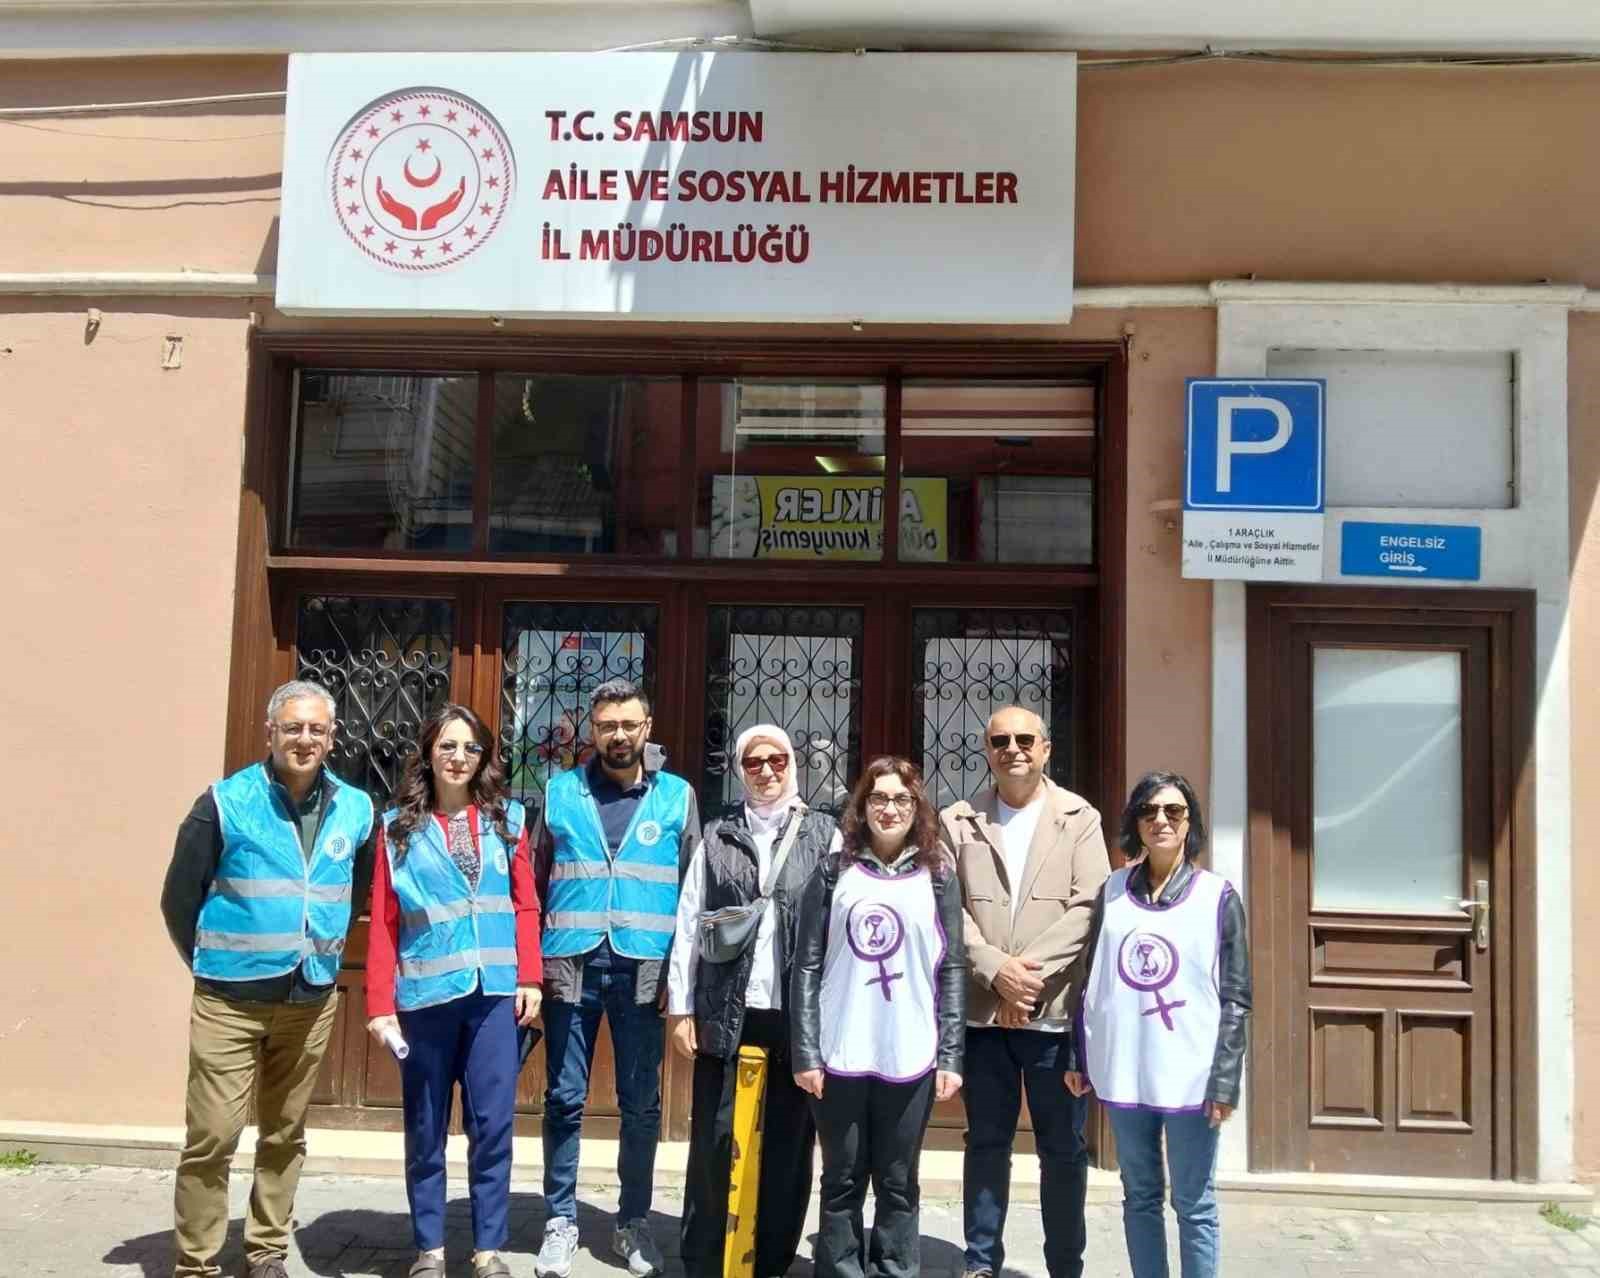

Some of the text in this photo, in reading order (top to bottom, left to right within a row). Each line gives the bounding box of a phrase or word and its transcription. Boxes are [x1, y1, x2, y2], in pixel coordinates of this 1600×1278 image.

[545, 110, 763, 142] T.C. SAMSUN
[542, 162, 1018, 204] AİLE VE SOSYAL HİZMETLER
[542, 221, 809, 264] İL MÜDÜRLÜĞÜ
[1216, 396, 1293, 493] P
[1379, 535, 1446, 549] ENGELSİZ
[1379, 550, 1416, 566] GİRİŞ
